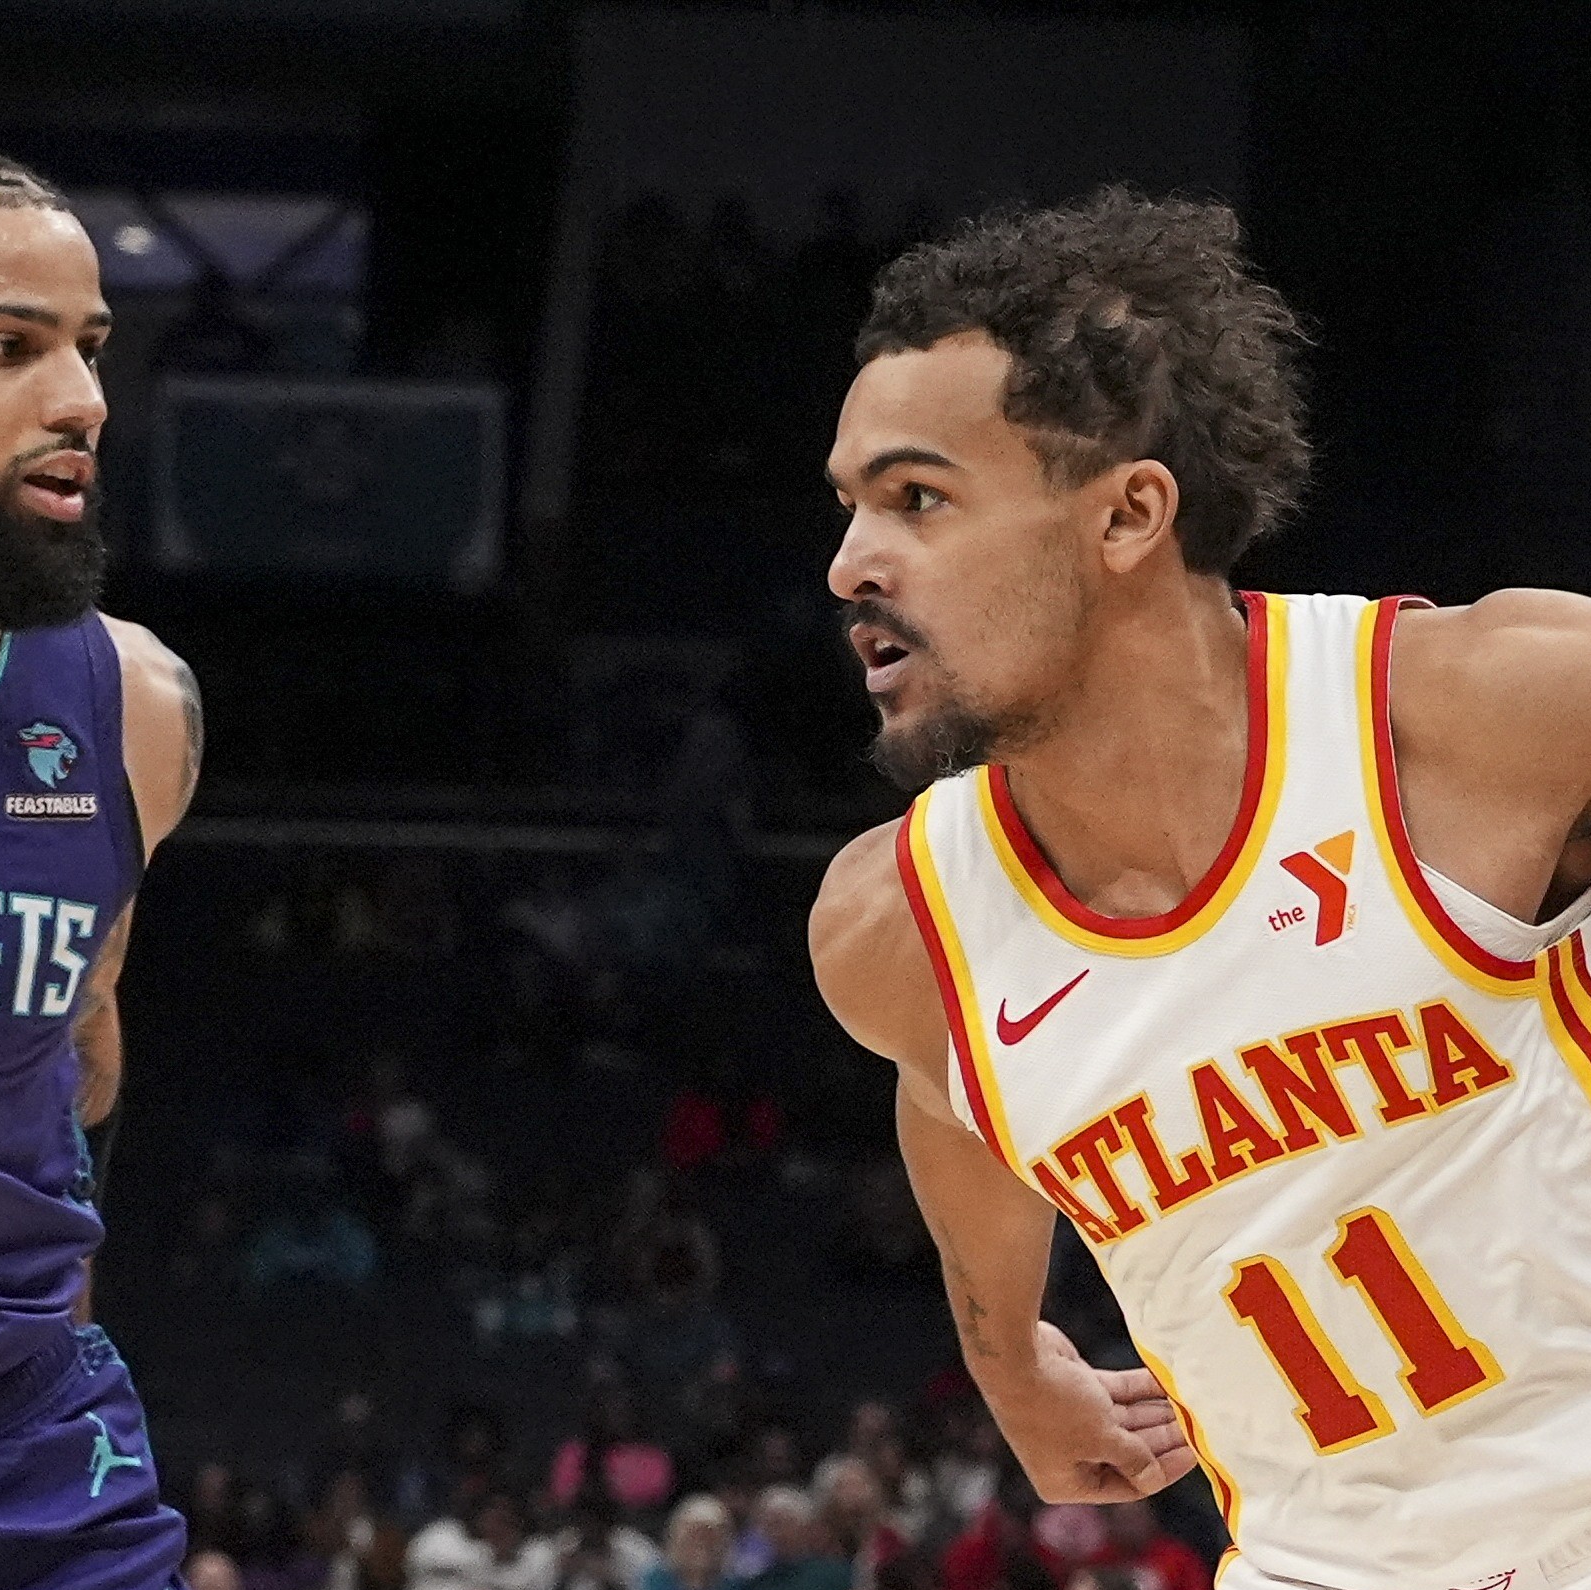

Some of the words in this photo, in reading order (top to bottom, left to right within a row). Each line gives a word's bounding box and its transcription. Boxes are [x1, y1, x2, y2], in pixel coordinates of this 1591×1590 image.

[5, 793, 98, 818] FEASTABLES
[1267, 905, 1306, 932] the
[1026, 996, 1517, 1247] ATLANTA
[1220, 1205, 1506, 1457] 11
